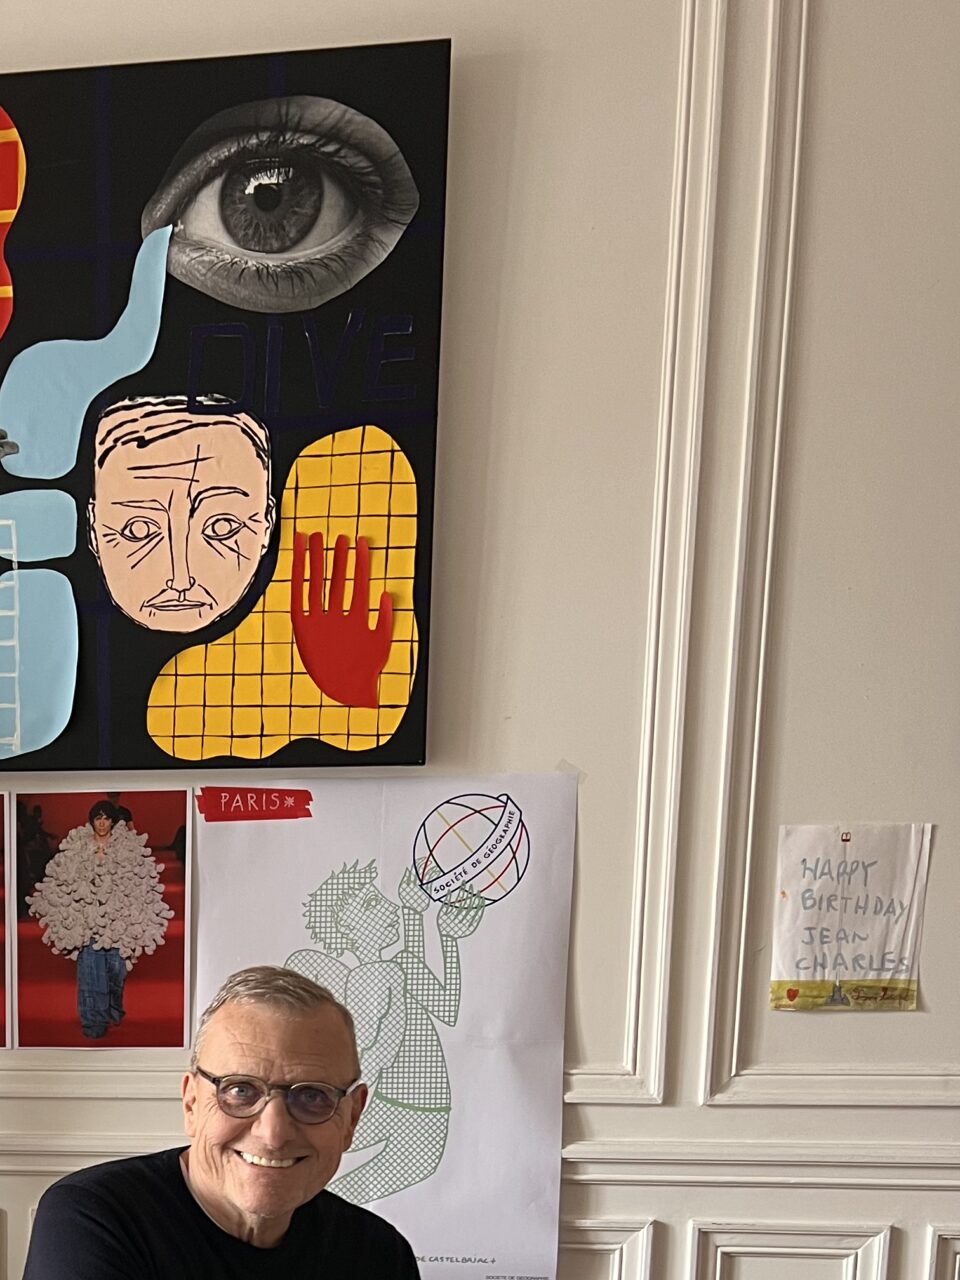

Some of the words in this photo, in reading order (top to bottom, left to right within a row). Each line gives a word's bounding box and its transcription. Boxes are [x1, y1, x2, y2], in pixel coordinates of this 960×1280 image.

[220, 792, 281, 812] PARIS
[433, 865, 469, 895] SOCIÉTÉ
[471, 856, 483, 869] DE
[483, 808, 517, 859] GÉOGRAPHIE
[800, 857, 879, 887] HAPPY
[800, 888, 909, 925] BIRTHDAY
[801, 926, 870, 946] JEAN
[795, 951, 910, 974] CHARLES
